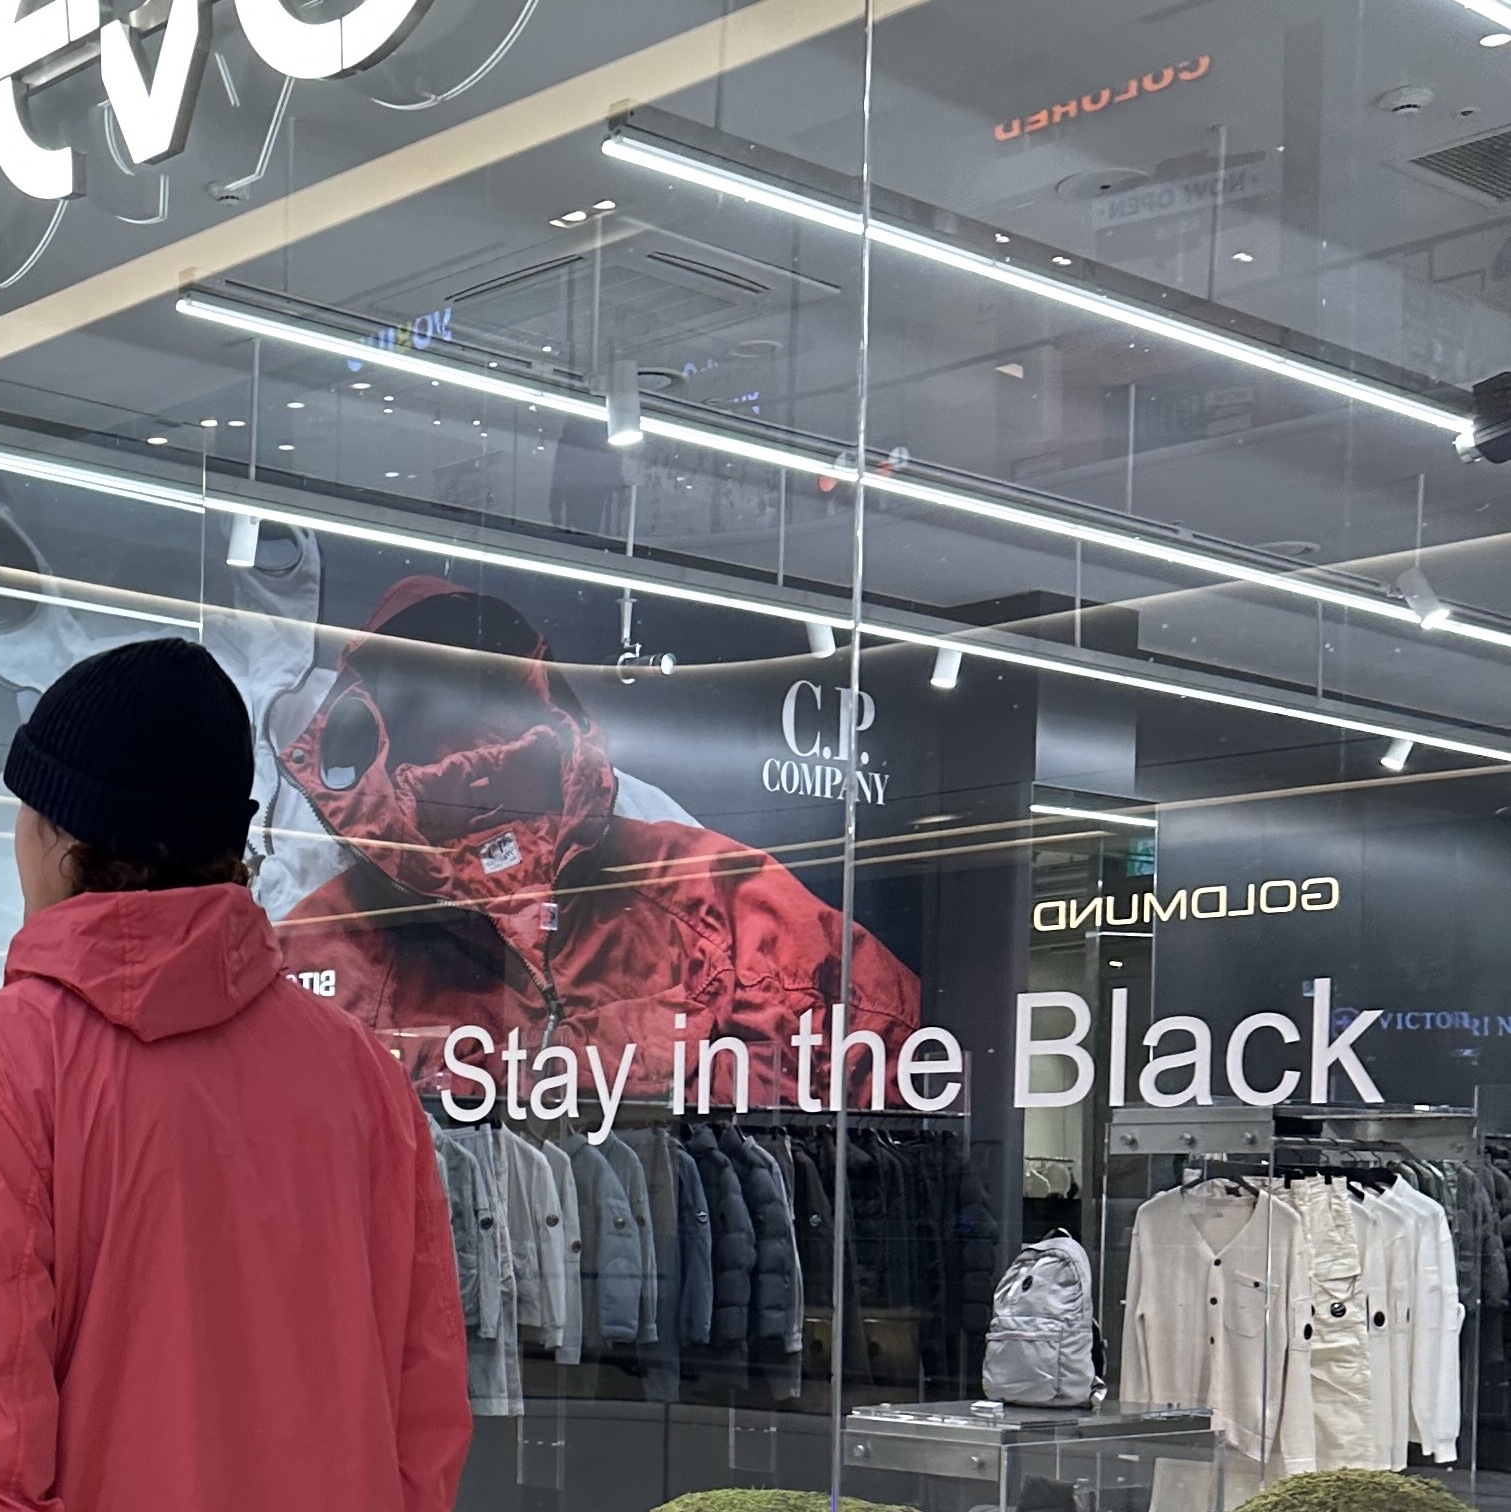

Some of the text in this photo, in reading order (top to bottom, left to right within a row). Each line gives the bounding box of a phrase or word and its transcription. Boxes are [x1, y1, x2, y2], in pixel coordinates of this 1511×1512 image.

[762, 757, 889, 806] COMPANY
[440, 977, 1385, 1146] Stay in the Black
